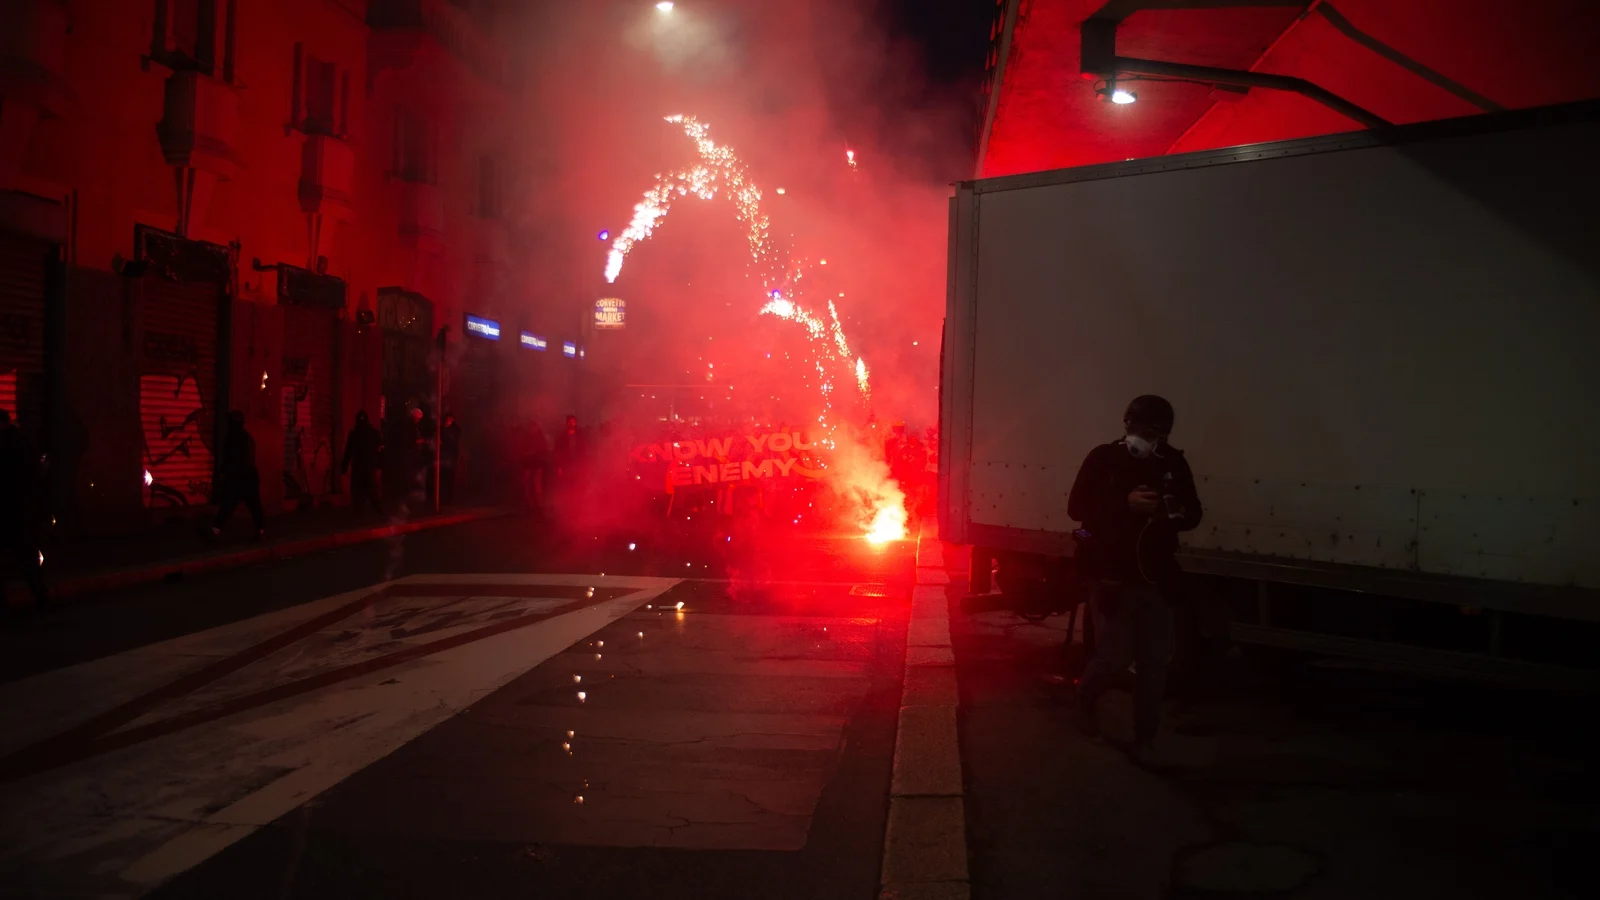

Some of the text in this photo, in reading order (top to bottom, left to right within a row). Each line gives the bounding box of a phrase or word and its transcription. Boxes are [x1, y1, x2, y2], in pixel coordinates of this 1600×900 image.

[595, 298, 626, 308] CORVETTO
[595, 312, 625, 323] MARKET
[745, 431, 829, 453] YOU
[673, 458, 797, 485] ENEMY
